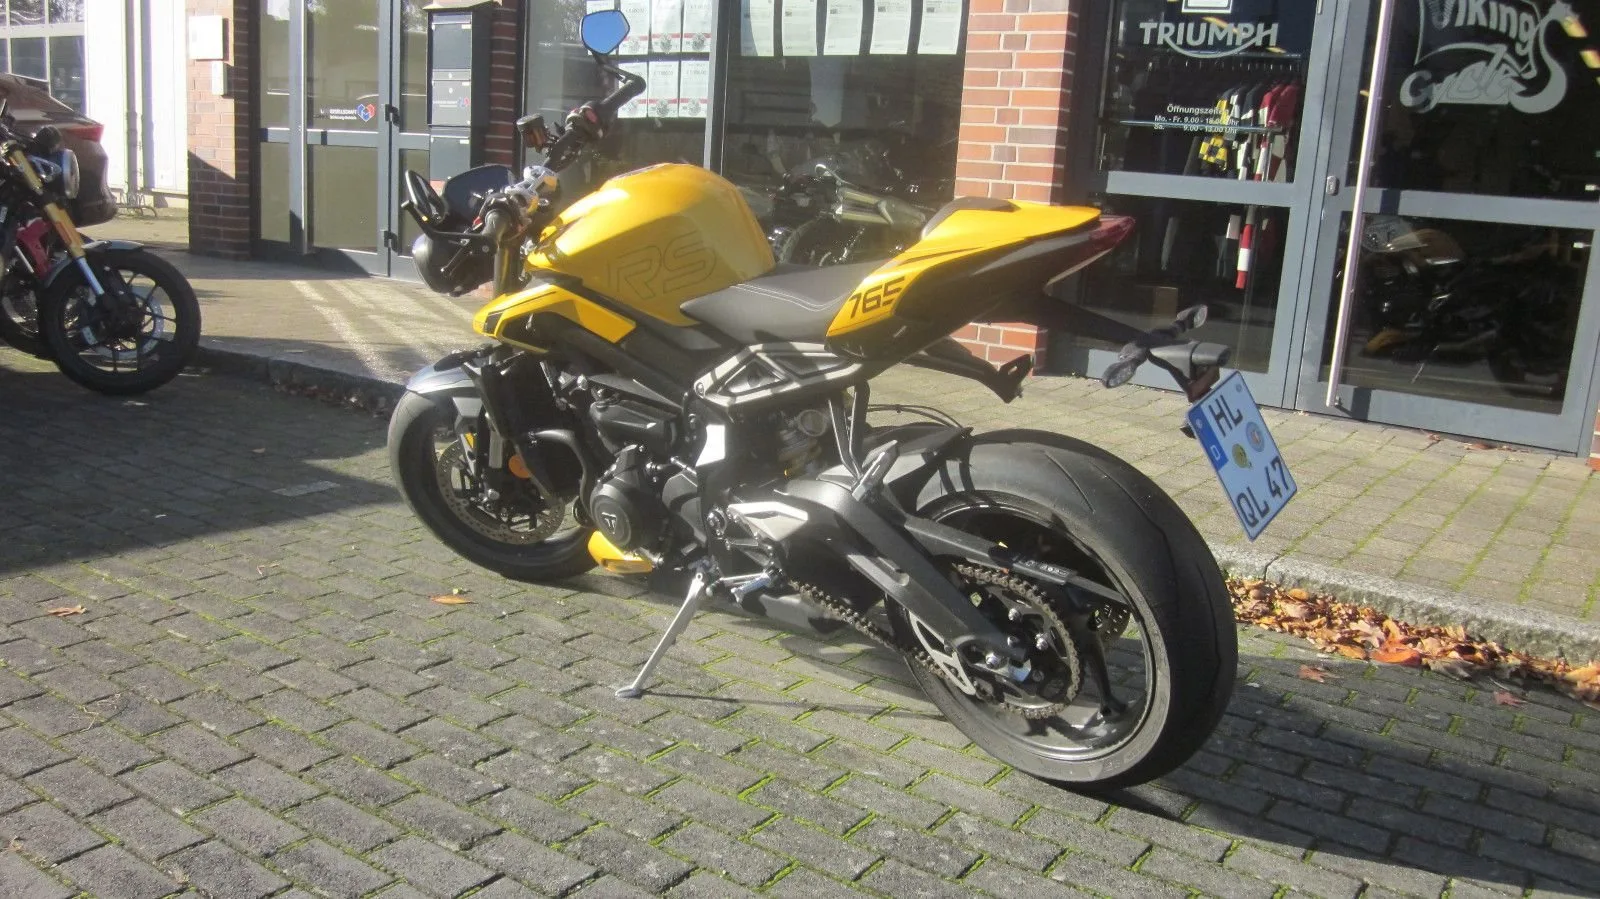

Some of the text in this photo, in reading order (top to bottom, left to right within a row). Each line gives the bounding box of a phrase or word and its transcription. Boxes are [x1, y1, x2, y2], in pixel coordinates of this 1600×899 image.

[1139, 21, 1279, 59] TRIUMPH
[1183, 116, 1199, 124] 9.00
[605, 229, 717, 300] RS
[850, 276, 905, 319] 765
[1208, 394, 1243, 438] HL
[1210, 444, 1221, 461] D
[1236, 455, 1289, 528] QL 47
